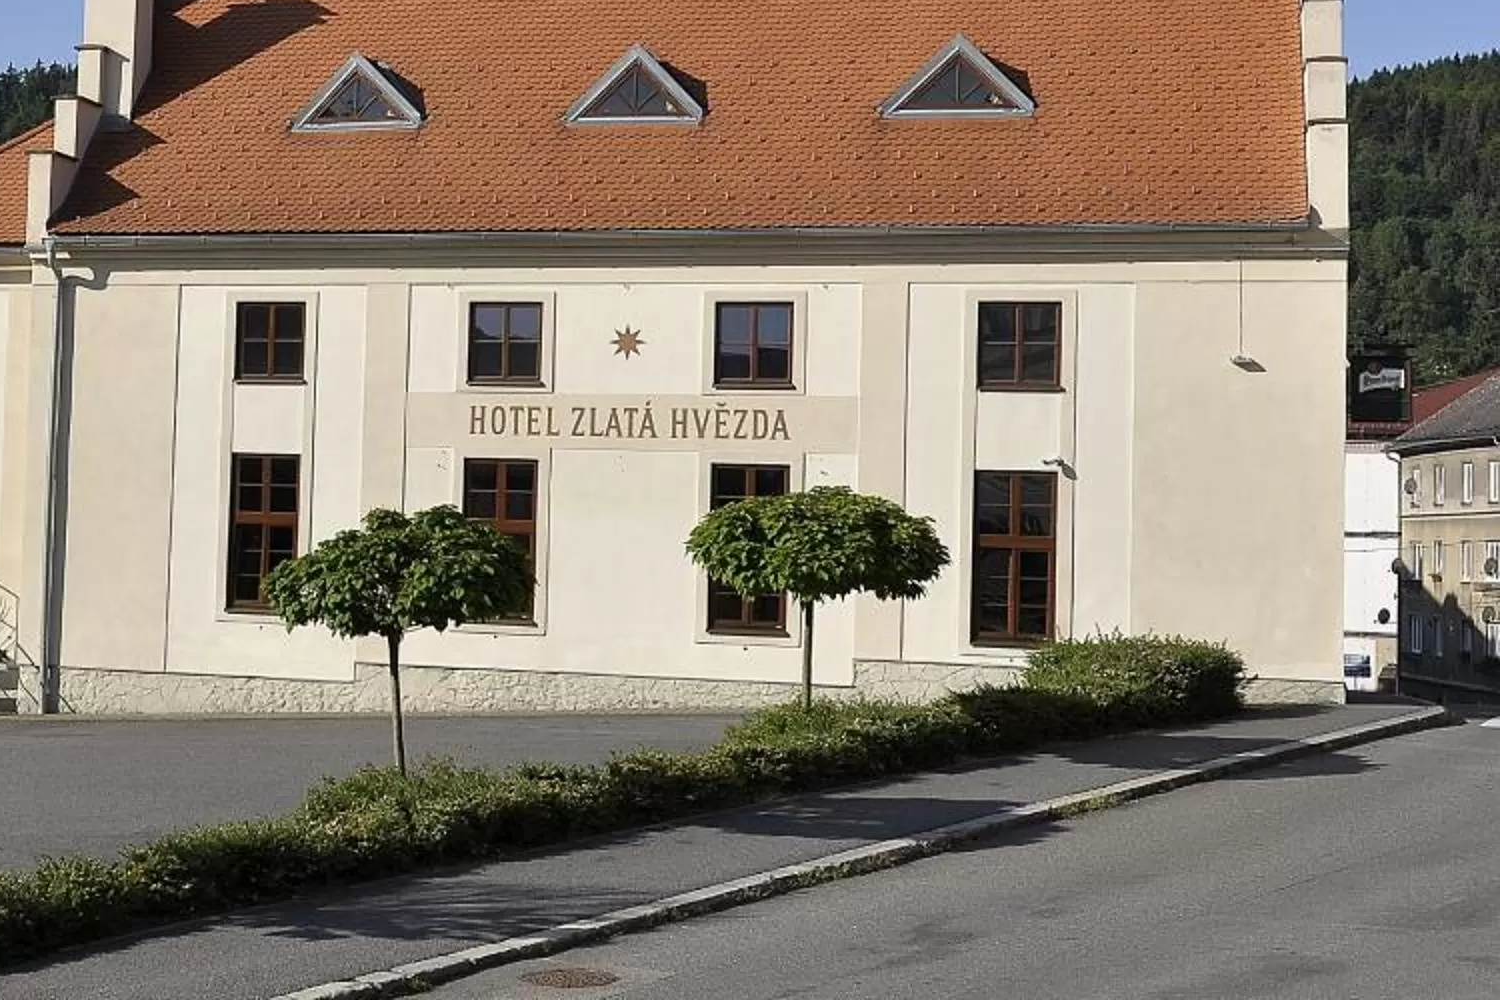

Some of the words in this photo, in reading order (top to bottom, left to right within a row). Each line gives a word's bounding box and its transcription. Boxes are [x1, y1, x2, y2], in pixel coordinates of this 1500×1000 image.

[469, 404, 560, 437] HOTEL
[571, 400, 658, 438] ZLATÁ
[670, 402, 792, 440] HVĚZDA
